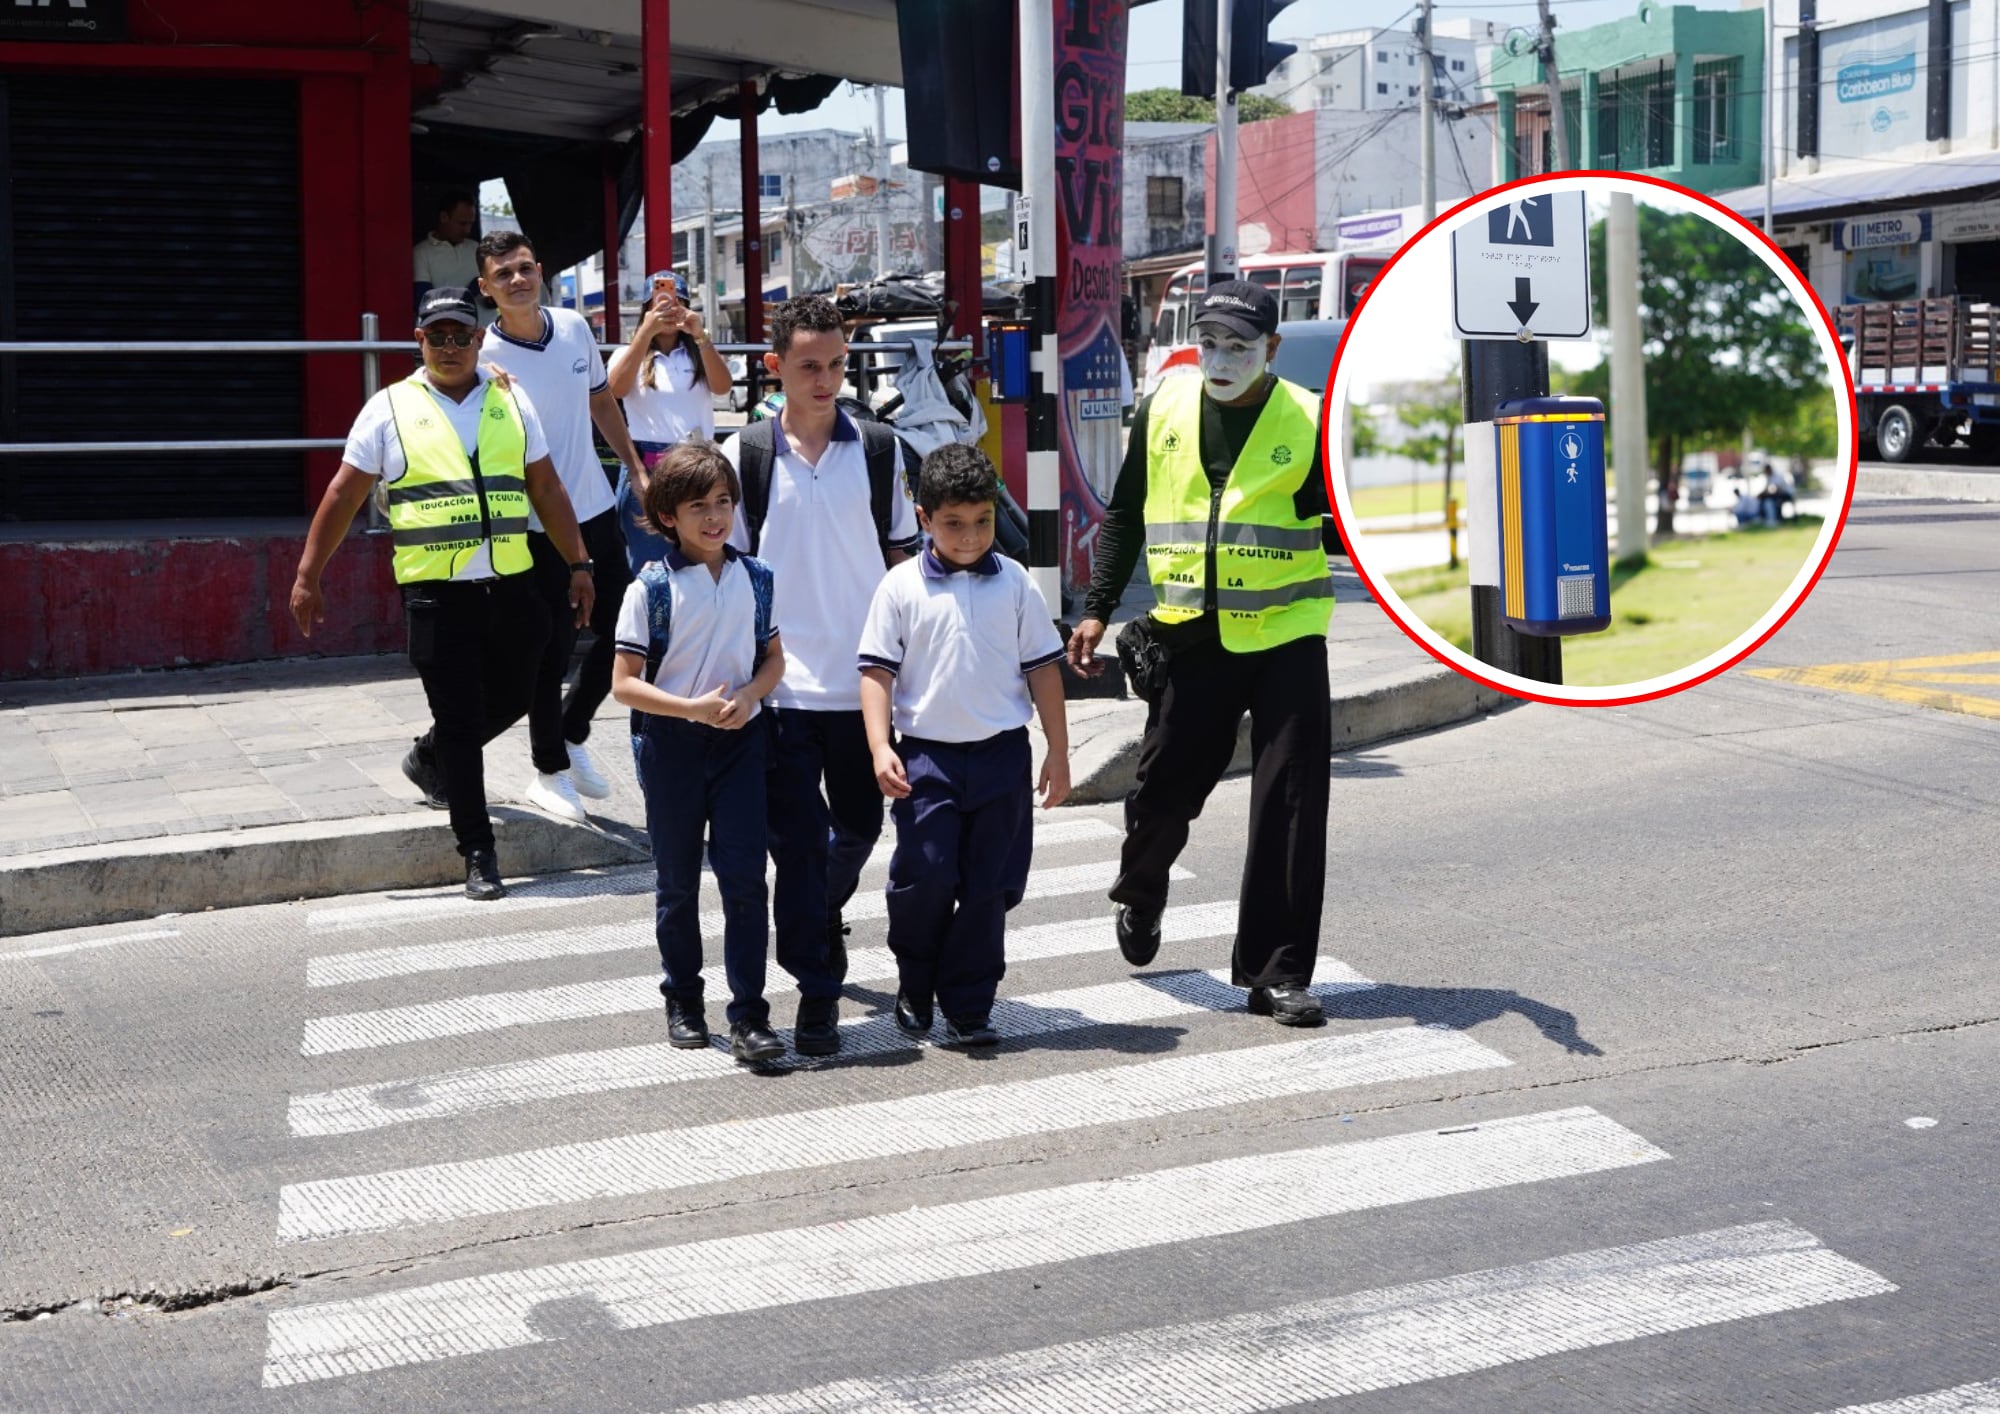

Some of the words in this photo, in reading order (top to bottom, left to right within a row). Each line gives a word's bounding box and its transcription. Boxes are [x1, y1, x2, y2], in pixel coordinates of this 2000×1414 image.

[1841, 78, 1890, 98] Caribbean
[1891, 72, 1913, 88] Blue
[1866, 219, 1902, 235] METRO
[1072, 258, 1110, 301] Desde
[450, 513, 479, 524] PARA
[491, 510, 502, 519] LA
[1227, 547, 1237, 556] Y
[1237, 547, 1293, 561] CULTURA
[1168, 572, 1195, 584] PARA
[1227, 577, 1244, 587] LA
